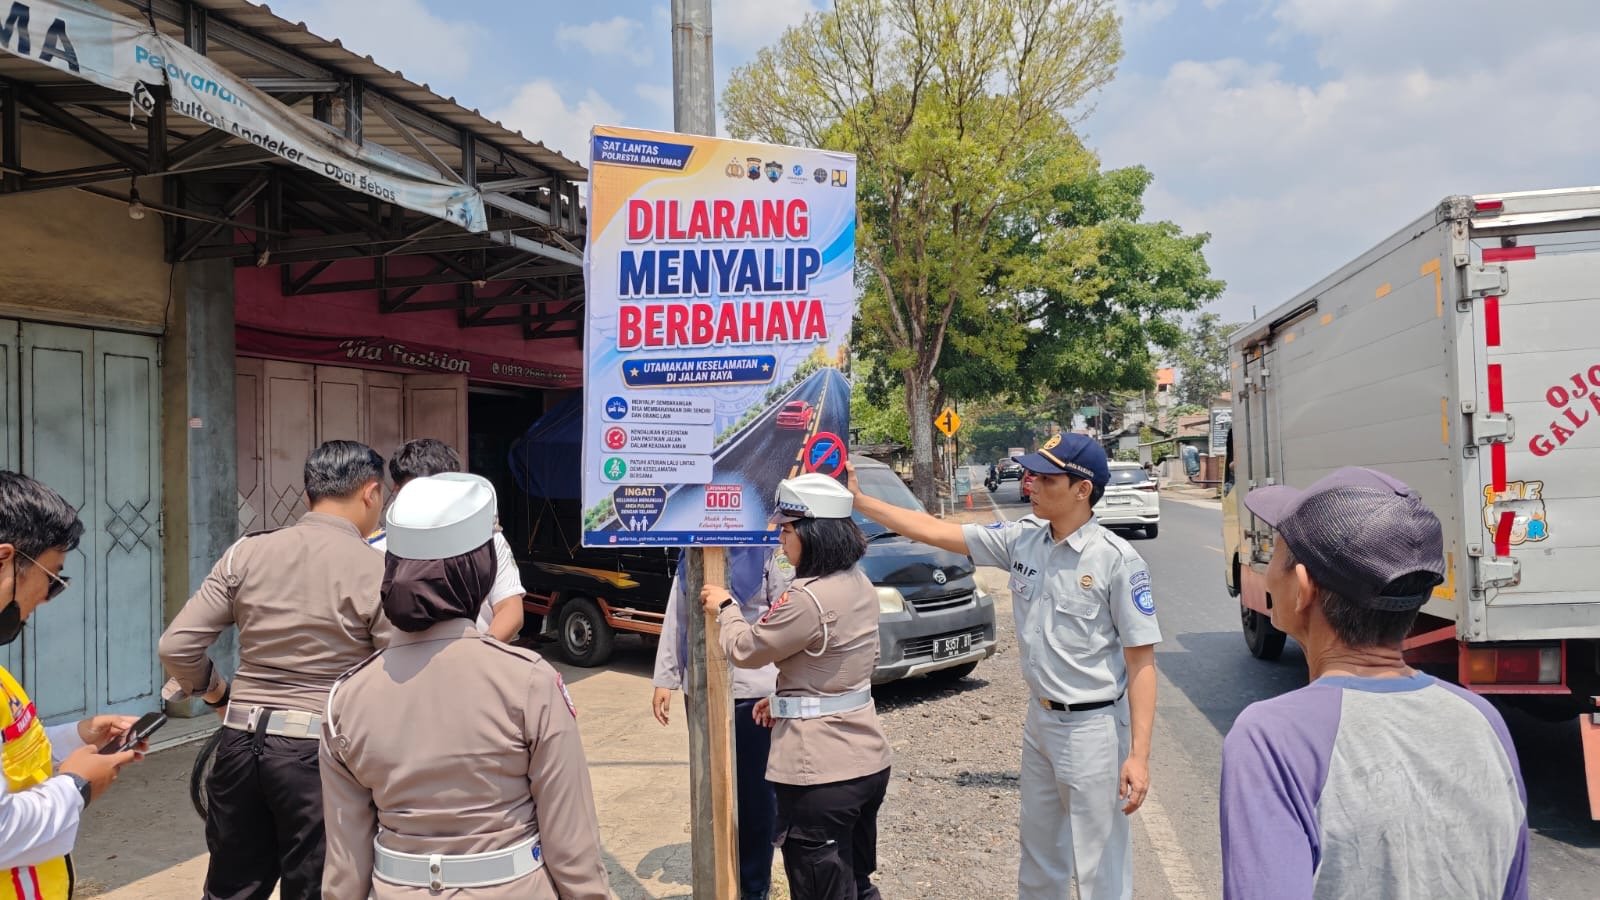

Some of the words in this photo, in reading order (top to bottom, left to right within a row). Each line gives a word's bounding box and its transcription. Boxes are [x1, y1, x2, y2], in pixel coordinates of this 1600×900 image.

[602, 140, 621, 150] SAT
[622, 144, 659, 155] LANTAS
[602, 152, 638, 162] POLRESTA
[640, 155, 682, 167] BANYUMAS
[360, 175, 396, 201] Bebas
[628, 198, 808, 240] DILARANG
[620, 248, 820, 296] MENYALIP
[619, 300, 828, 348] BERBAHAYA
[388, 344, 471, 374] Fashion
[644, 361, 694, 373] UTAMAKAN
[696, 359, 758, 371] KESELAMATAN
[666, 372, 676, 382] DI
[678, 372, 708, 382] JALAN
[711, 370, 732, 380] RAYA
[625, 488, 656, 496] INGAT!
[708, 494, 740, 506] 110
[1013, 560, 1037, 577] ARIF
[934, 641, 939, 653] R
